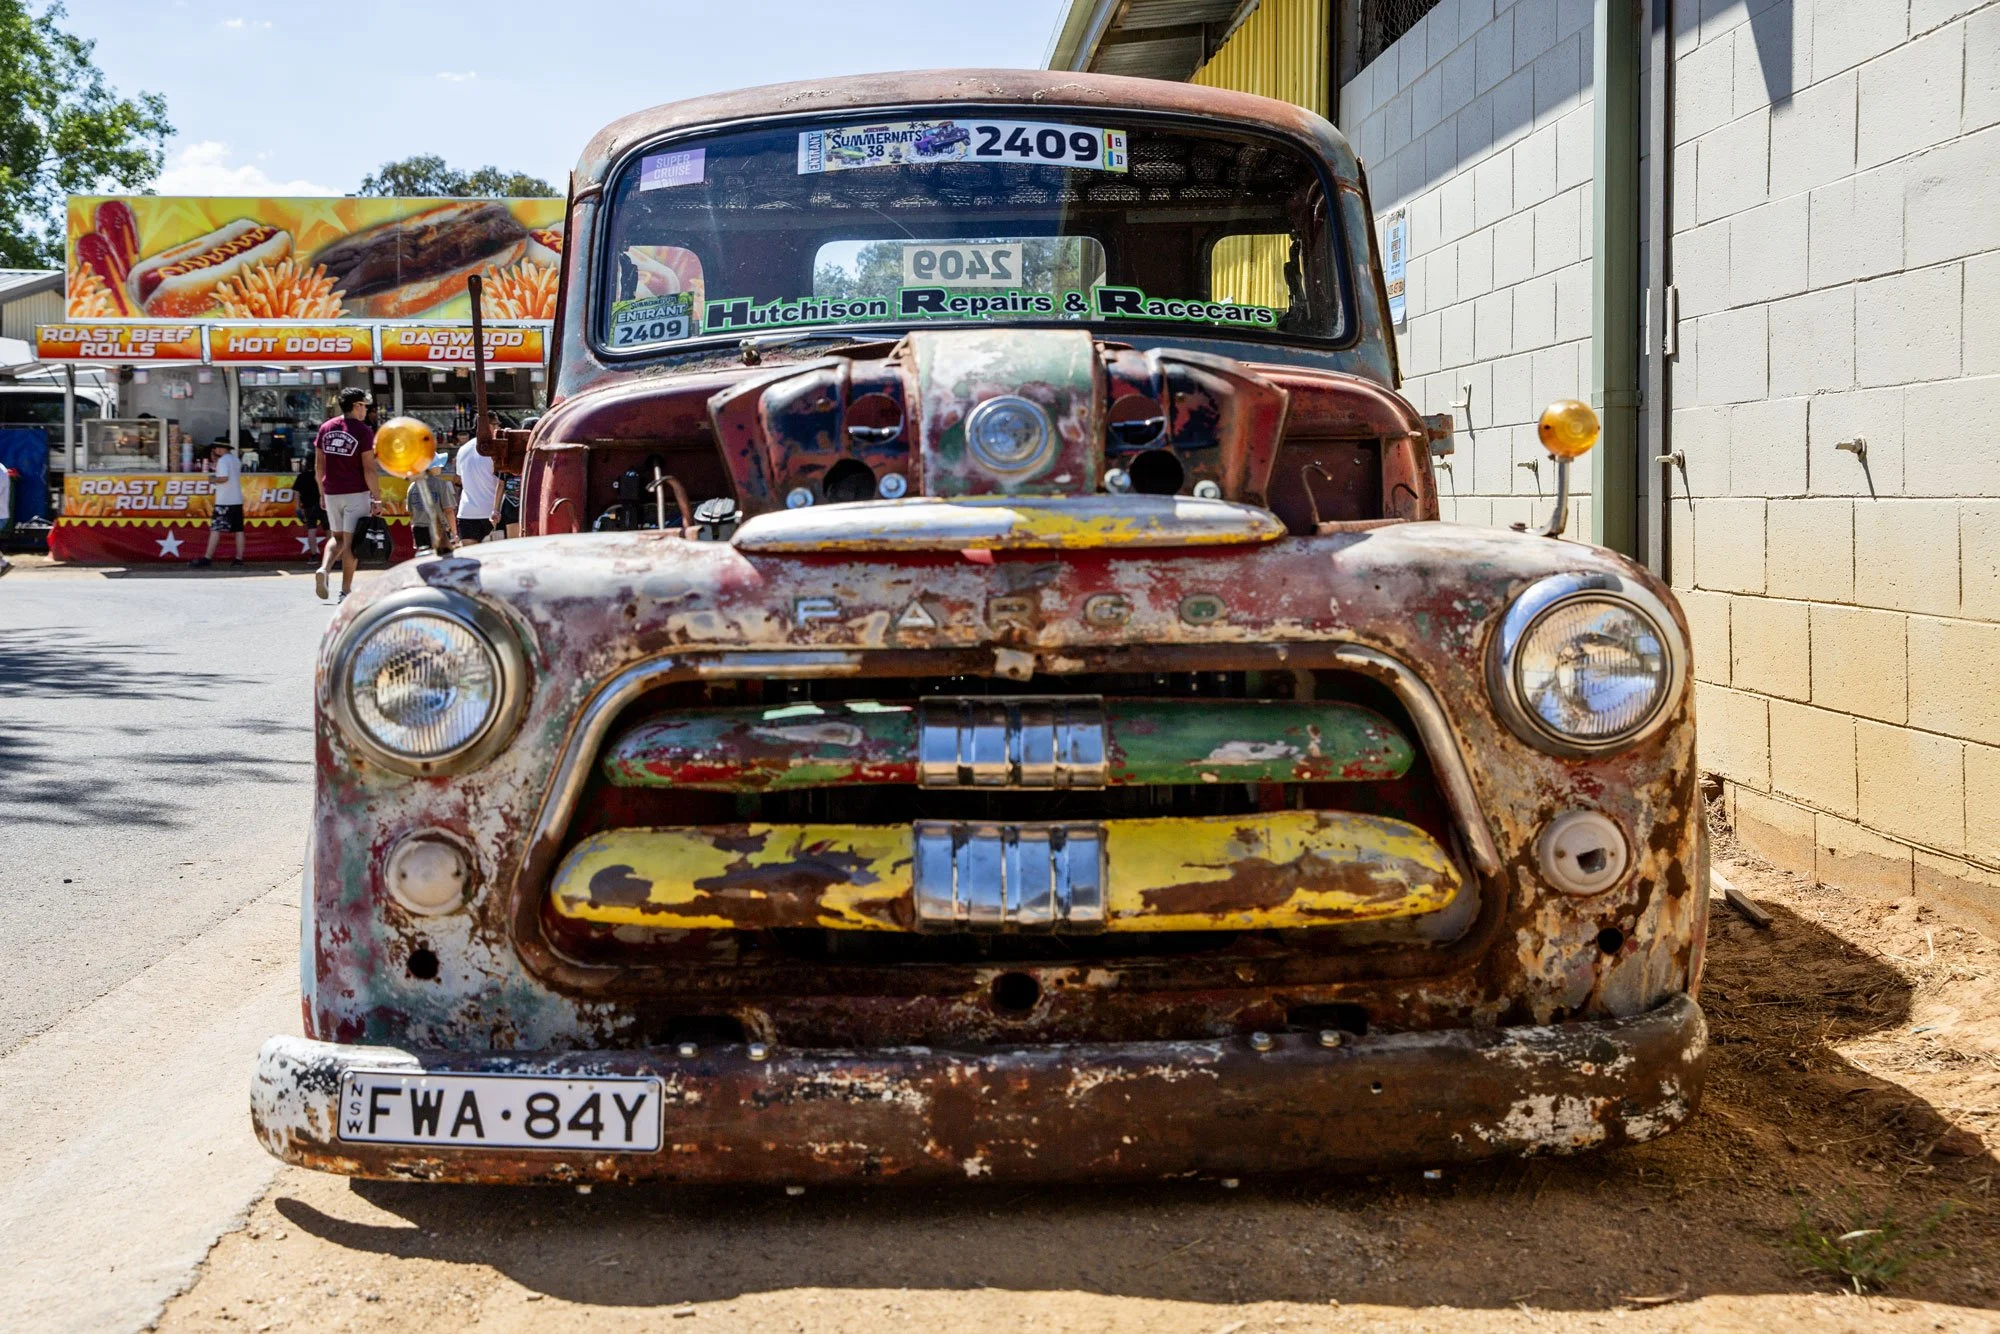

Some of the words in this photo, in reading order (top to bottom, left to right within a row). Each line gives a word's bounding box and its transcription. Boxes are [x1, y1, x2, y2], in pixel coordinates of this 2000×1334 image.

[831, 130, 923, 149] SUMMERNATS
[975, 126, 1099, 162] 2409
[1115, 137, 1122, 147] B
[808, 133, 822, 171] ENTRANT
[866, 144, 885, 158] 38
[656, 153, 690, 168] SUPER
[1116, 154, 1123, 165] D
[654, 164, 692, 180] CRUISE
[616, 304, 687, 324] ENTRANT
[706, 298, 887, 328] Hutchison
[901, 289, 1052, 317] Repairs
[1064, 291, 1088, 313] &
[1097, 289, 1274, 324] Racecars
[42, 328, 124, 343] ROAST
[131, 328, 193, 343] BEEF
[619, 320, 682, 345] 2409
[79, 342, 157, 358] ROLLS
[228, 337, 280, 353] HOT
[285, 337, 353, 353] DOGS
[79, 480, 158, 496] ROAST
[115, 495, 189, 511] ROLLS
[793, 592, 1227, 630] FARGO
[347, 1083, 364, 1134] NSW
